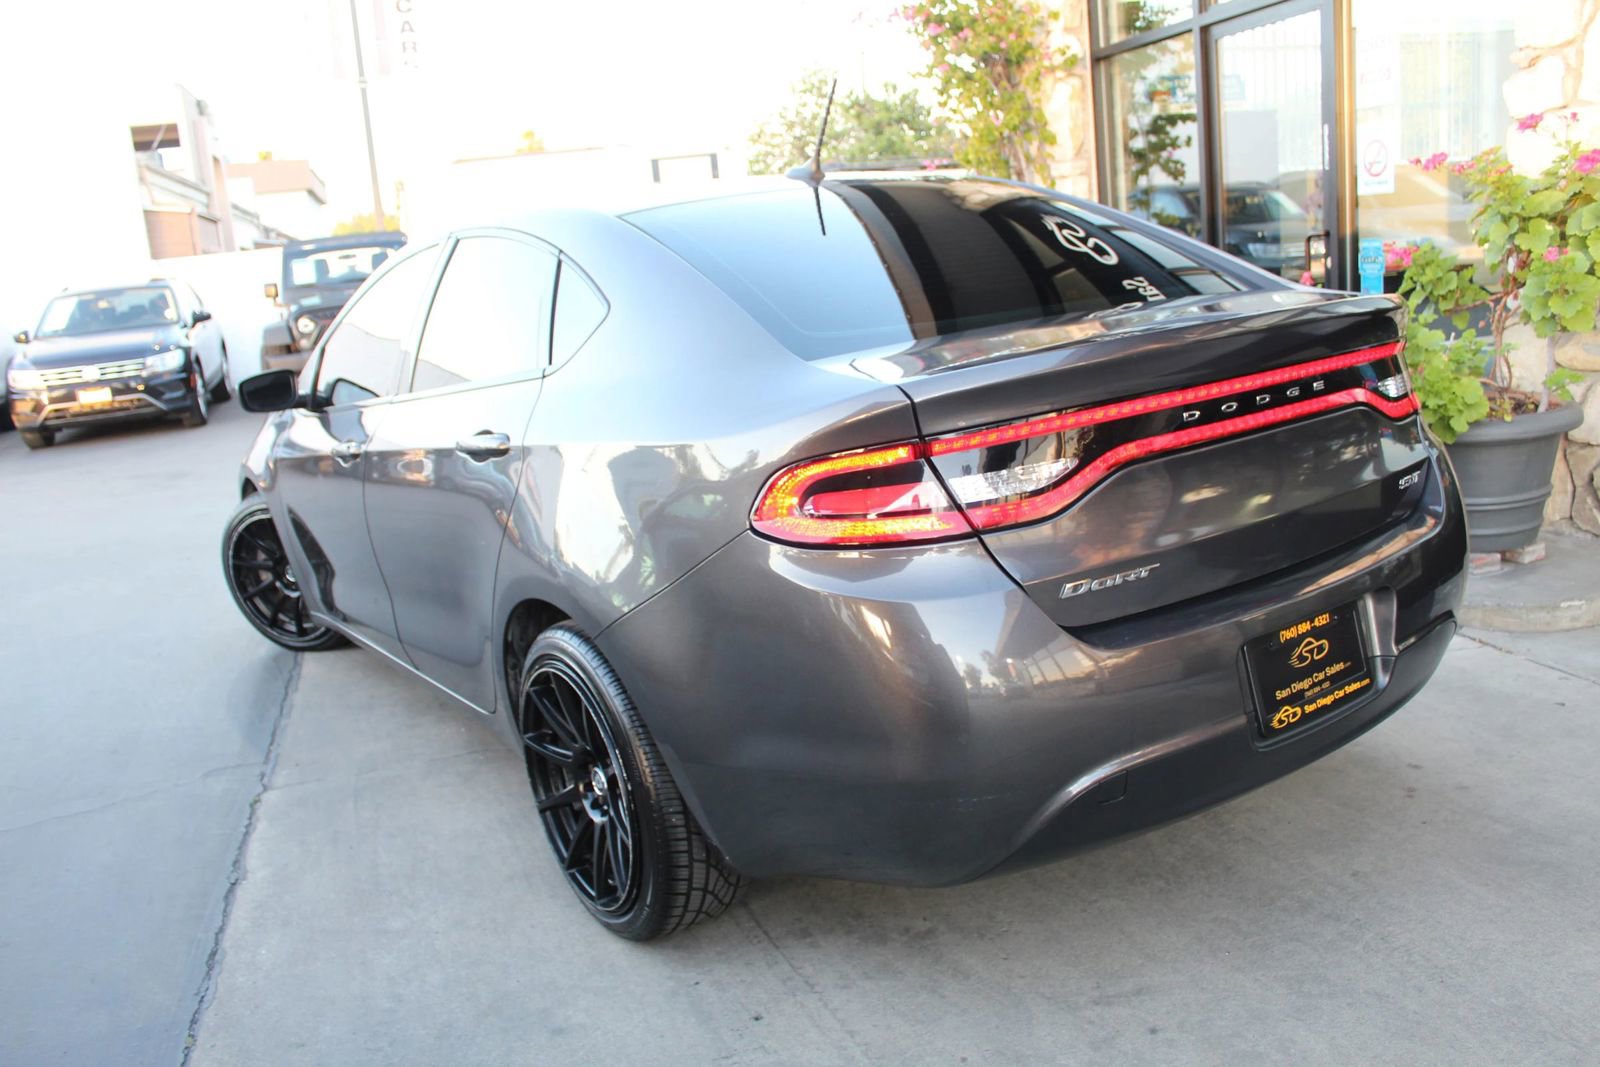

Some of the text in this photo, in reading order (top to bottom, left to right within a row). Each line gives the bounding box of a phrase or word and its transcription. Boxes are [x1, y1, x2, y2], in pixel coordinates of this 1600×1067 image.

[1182, 380, 1325, 422] DODGE
[1399, 471, 1421, 489] GT
[1275, 686, 1291, 700] San
[1291, 677, 1313, 695] Diego
[1312, 671, 1325, 683] Car
[1304, 702, 1317, 714] San
[1316, 693, 1334, 708] Diego
[1334, 689, 1345, 700] Car
